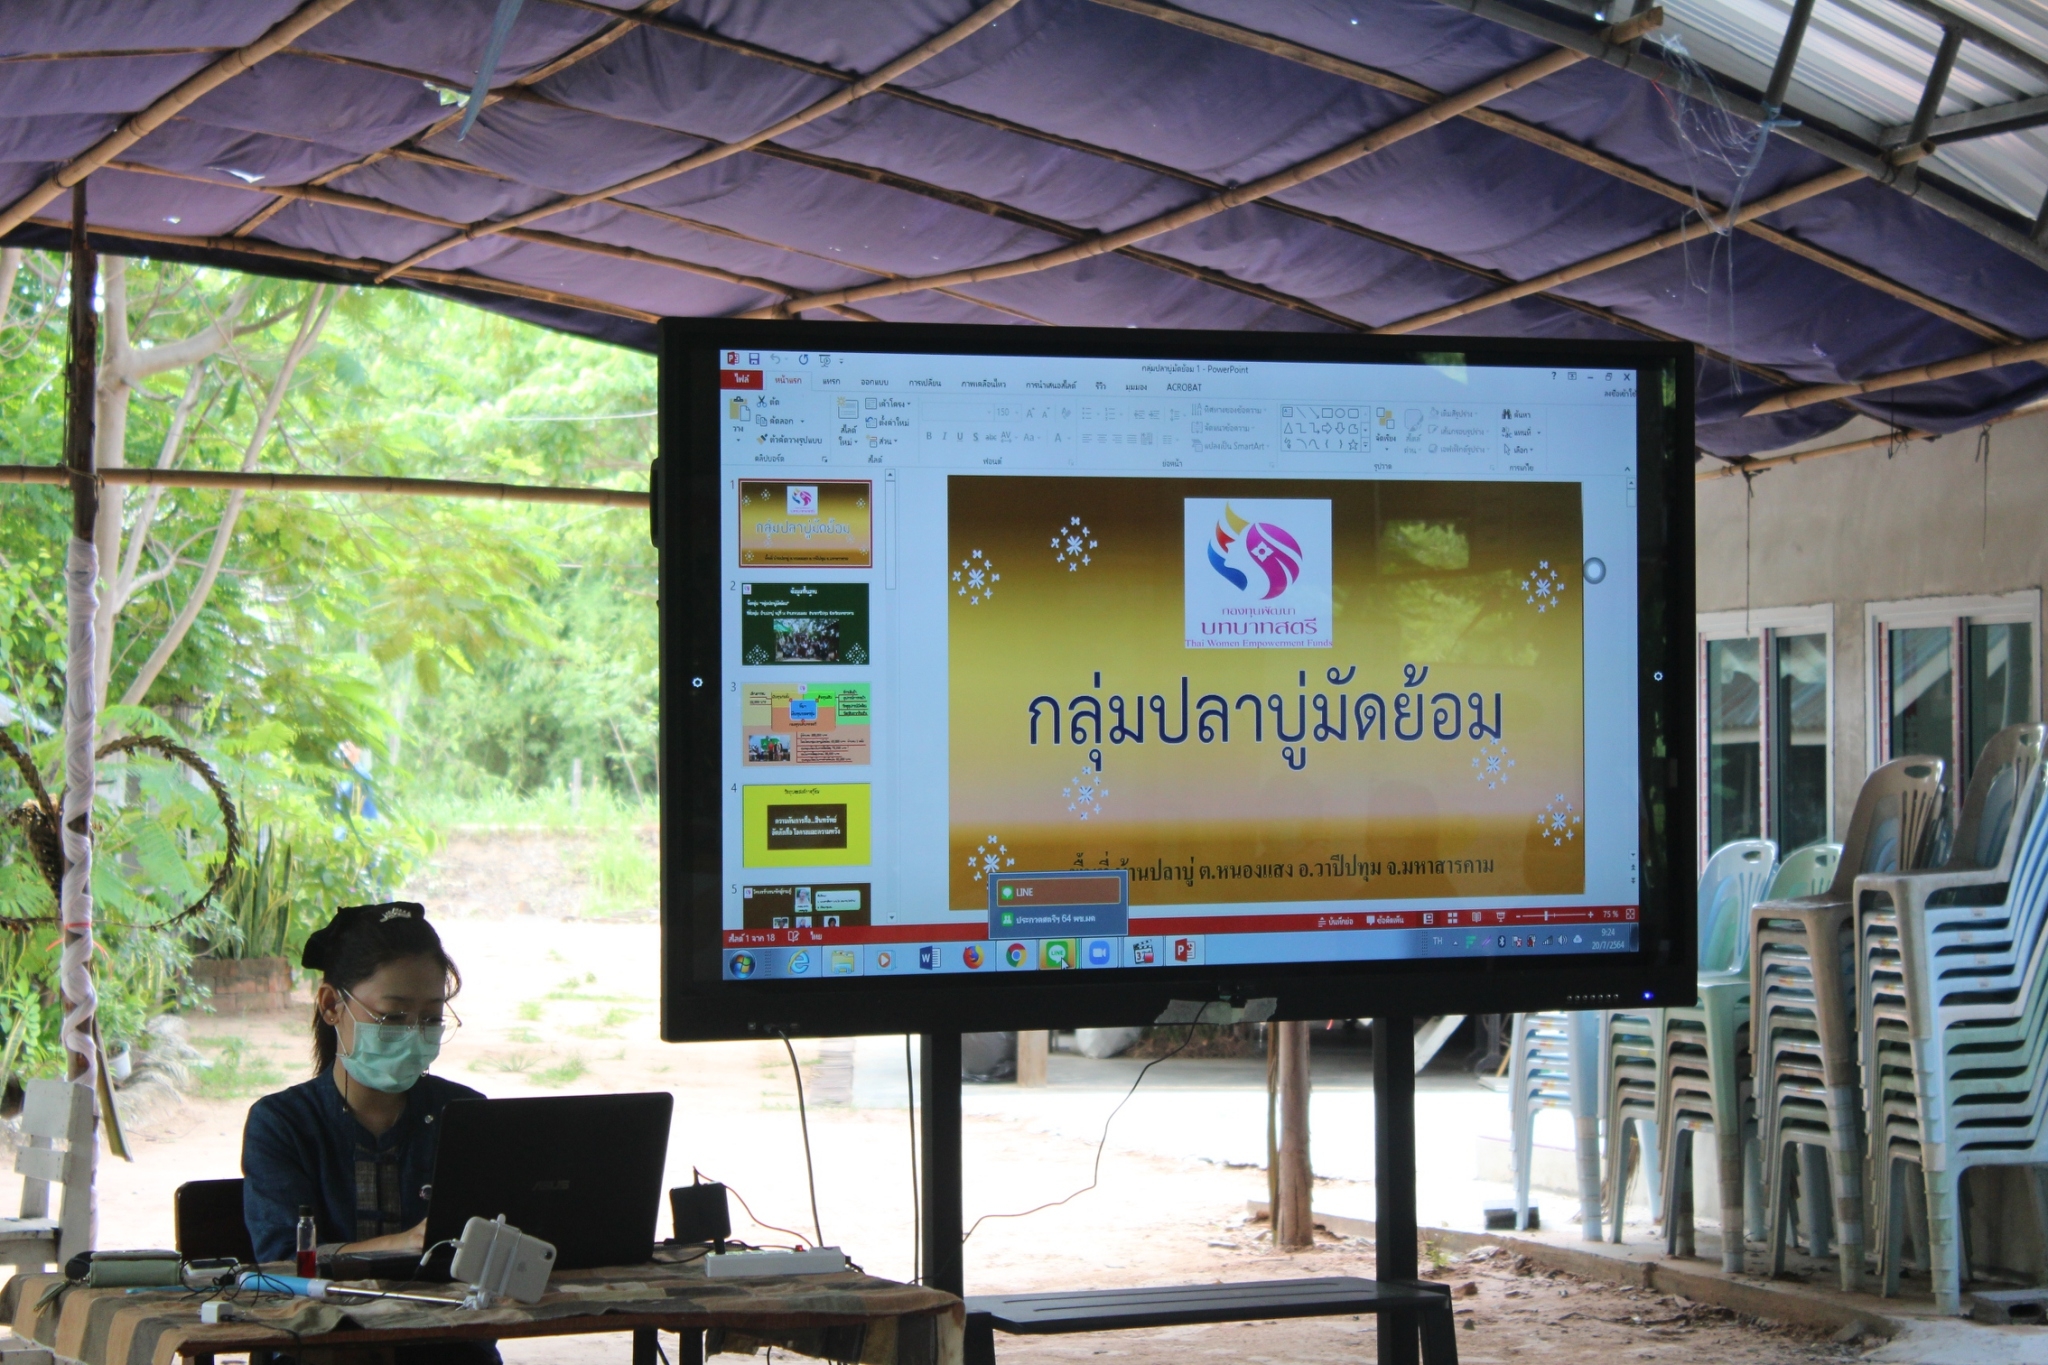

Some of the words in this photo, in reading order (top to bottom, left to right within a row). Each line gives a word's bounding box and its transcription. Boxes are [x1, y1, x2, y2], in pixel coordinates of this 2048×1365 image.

[1142, 364, 1195, 375] กลุ่มปลาบู่มัดย้อม
[1207, 365, 1249, 374] PowerPoint
[735, 373, 749, 383] ไฟล์
[775, 374, 802, 384] หน้าแรก
[861, 378, 889, 386] ออกแบบ
[909, 378, 942, 387] การเปลี่ยน
[961, 378, 1007, 388] ภาพเคลื่อนไหว
[1026, 379, 1077, 390] การนำเสนอสไลด์
[1125, 384, 1148, 393] มุมมอง
[1166, 383, 1202, 392] ACROBAT
[769, 398, 780, 406] ตัด
[997, 408, 1010, 417] 150
[1514, 410, 1531, 419] ค้นหา
[769, 417, 794, 426] คัดลอก
[879, 415, 910, 427] ตั้งค่าใหม่
[840, 425, 858, 434] สไลด์
[770, 436, 823, 446] ตัวคัดวางรูปแบบ
[838, 437, 853, 446] ใหม่
[1233, 441, 1265, 451] SmartArt
[1514, 446, 1528, 454] เลือก
[868, 455, 883, 464] สไลด์
[983, 456, 1002, 466] ฟอนต์
[1162, 458, 1183, 468] ย่อหน้า
[1374, 462, 1393, 472] รูปวาด
[756, 518, 851, 540] กลุ่มปลาบู่มัดย้อม
[730, 580, 736, 591] 2
[1221, 606, 1296, 618] กองทุนพัฒนา
[1201, 617, 1318, 636] บทบาทสตรี
[1185, 639, 1205, 647] Thai
[1207, 639, 1240, 647] Women
[1242, 639, 1305, 649] Empowerment
[1307, 639, 1333, 647] Funds
[730, 681, 737, 692] 3
[1028, 662, 1502, 772] กลุ่มปลาบู่มัดย้อม
[731, 783, 737, 793] 4
[1116, 857, 1195, 887] ้านปลาบู่
[1199, 863, 1293, 881] ต.หนองแสง
[1298, 853, 1382, 883] อ.วาปีปทุม
[1387, 857, 1495, 877] จ.มหาสารคาม
[731, 884, 738, 895] 5
[1016, 887, 1034, 897] LINE
[1061, 914, 1072, 923] 64
[1612, 910, 1619, 918] %
[1328, 916, 1354, 926] บันทึกย่อ
[728, 932, 745, 943] สไลด์
[751, 934, 765, 943] จาก
[766, 933, 776, 942] 18
[810, 931, 823, 941] ไทย
[1601, 928, 1616, 937] 9:24
[1432, 937, 1443, 945] TH
[1592, 940, 1625, 950] 20/7/2564
